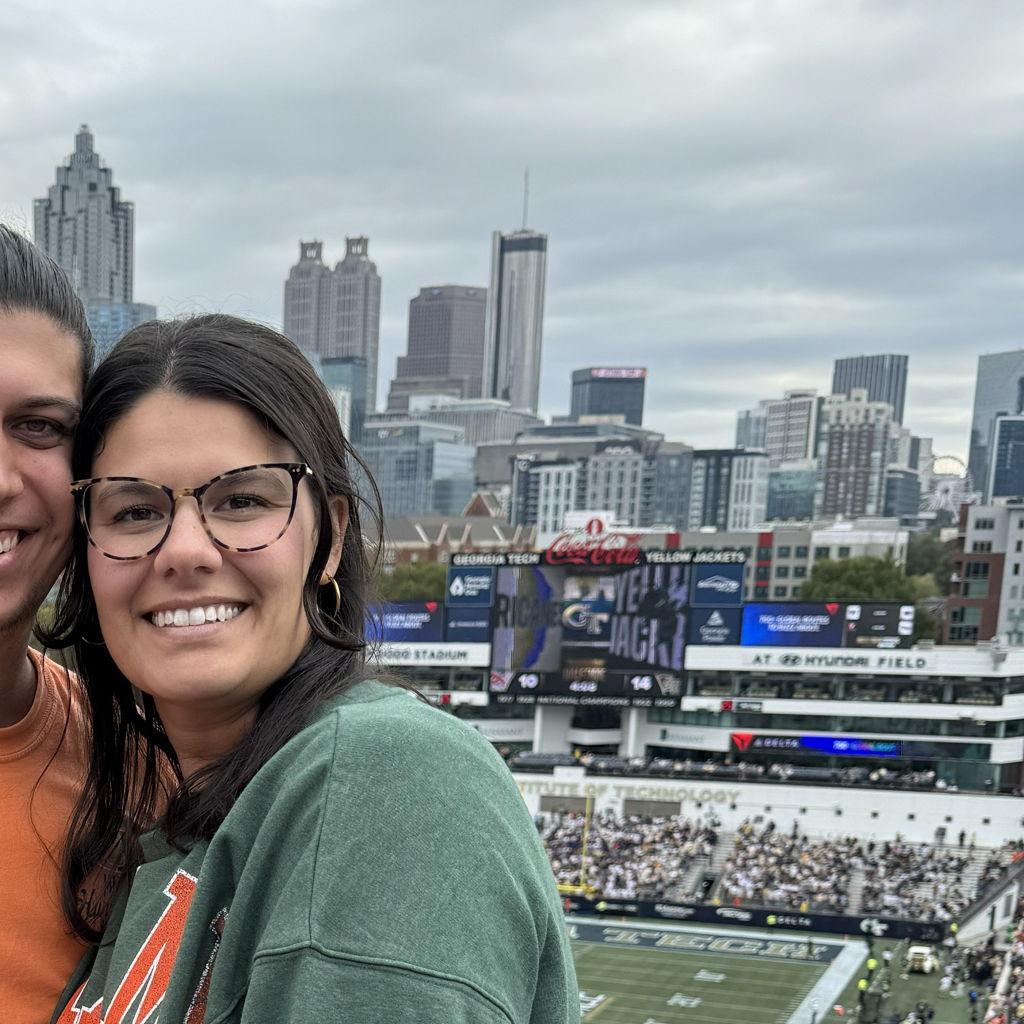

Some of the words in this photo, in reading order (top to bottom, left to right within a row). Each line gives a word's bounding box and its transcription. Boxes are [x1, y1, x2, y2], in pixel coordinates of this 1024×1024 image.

[453, 553, 506, 566] GEORGIA
[508, 552, 541, 565] TECH
[645, 551, 691, 563] YELLOW
[693, 551, 746, 563] JACKETS
[414, 650, 468, 660] STADIUM
[752, 655, 771, 664] AT
[804, 656, 869, 667] HYUNDAI
[878, 658, 926, 669] FIELD
[518, 673, 539, 689] 10
[631, 675, 653, 691] 14
[764, 738, 800, 748] DELTA
[612, 785, 740, 802] TECHNOLOGY
